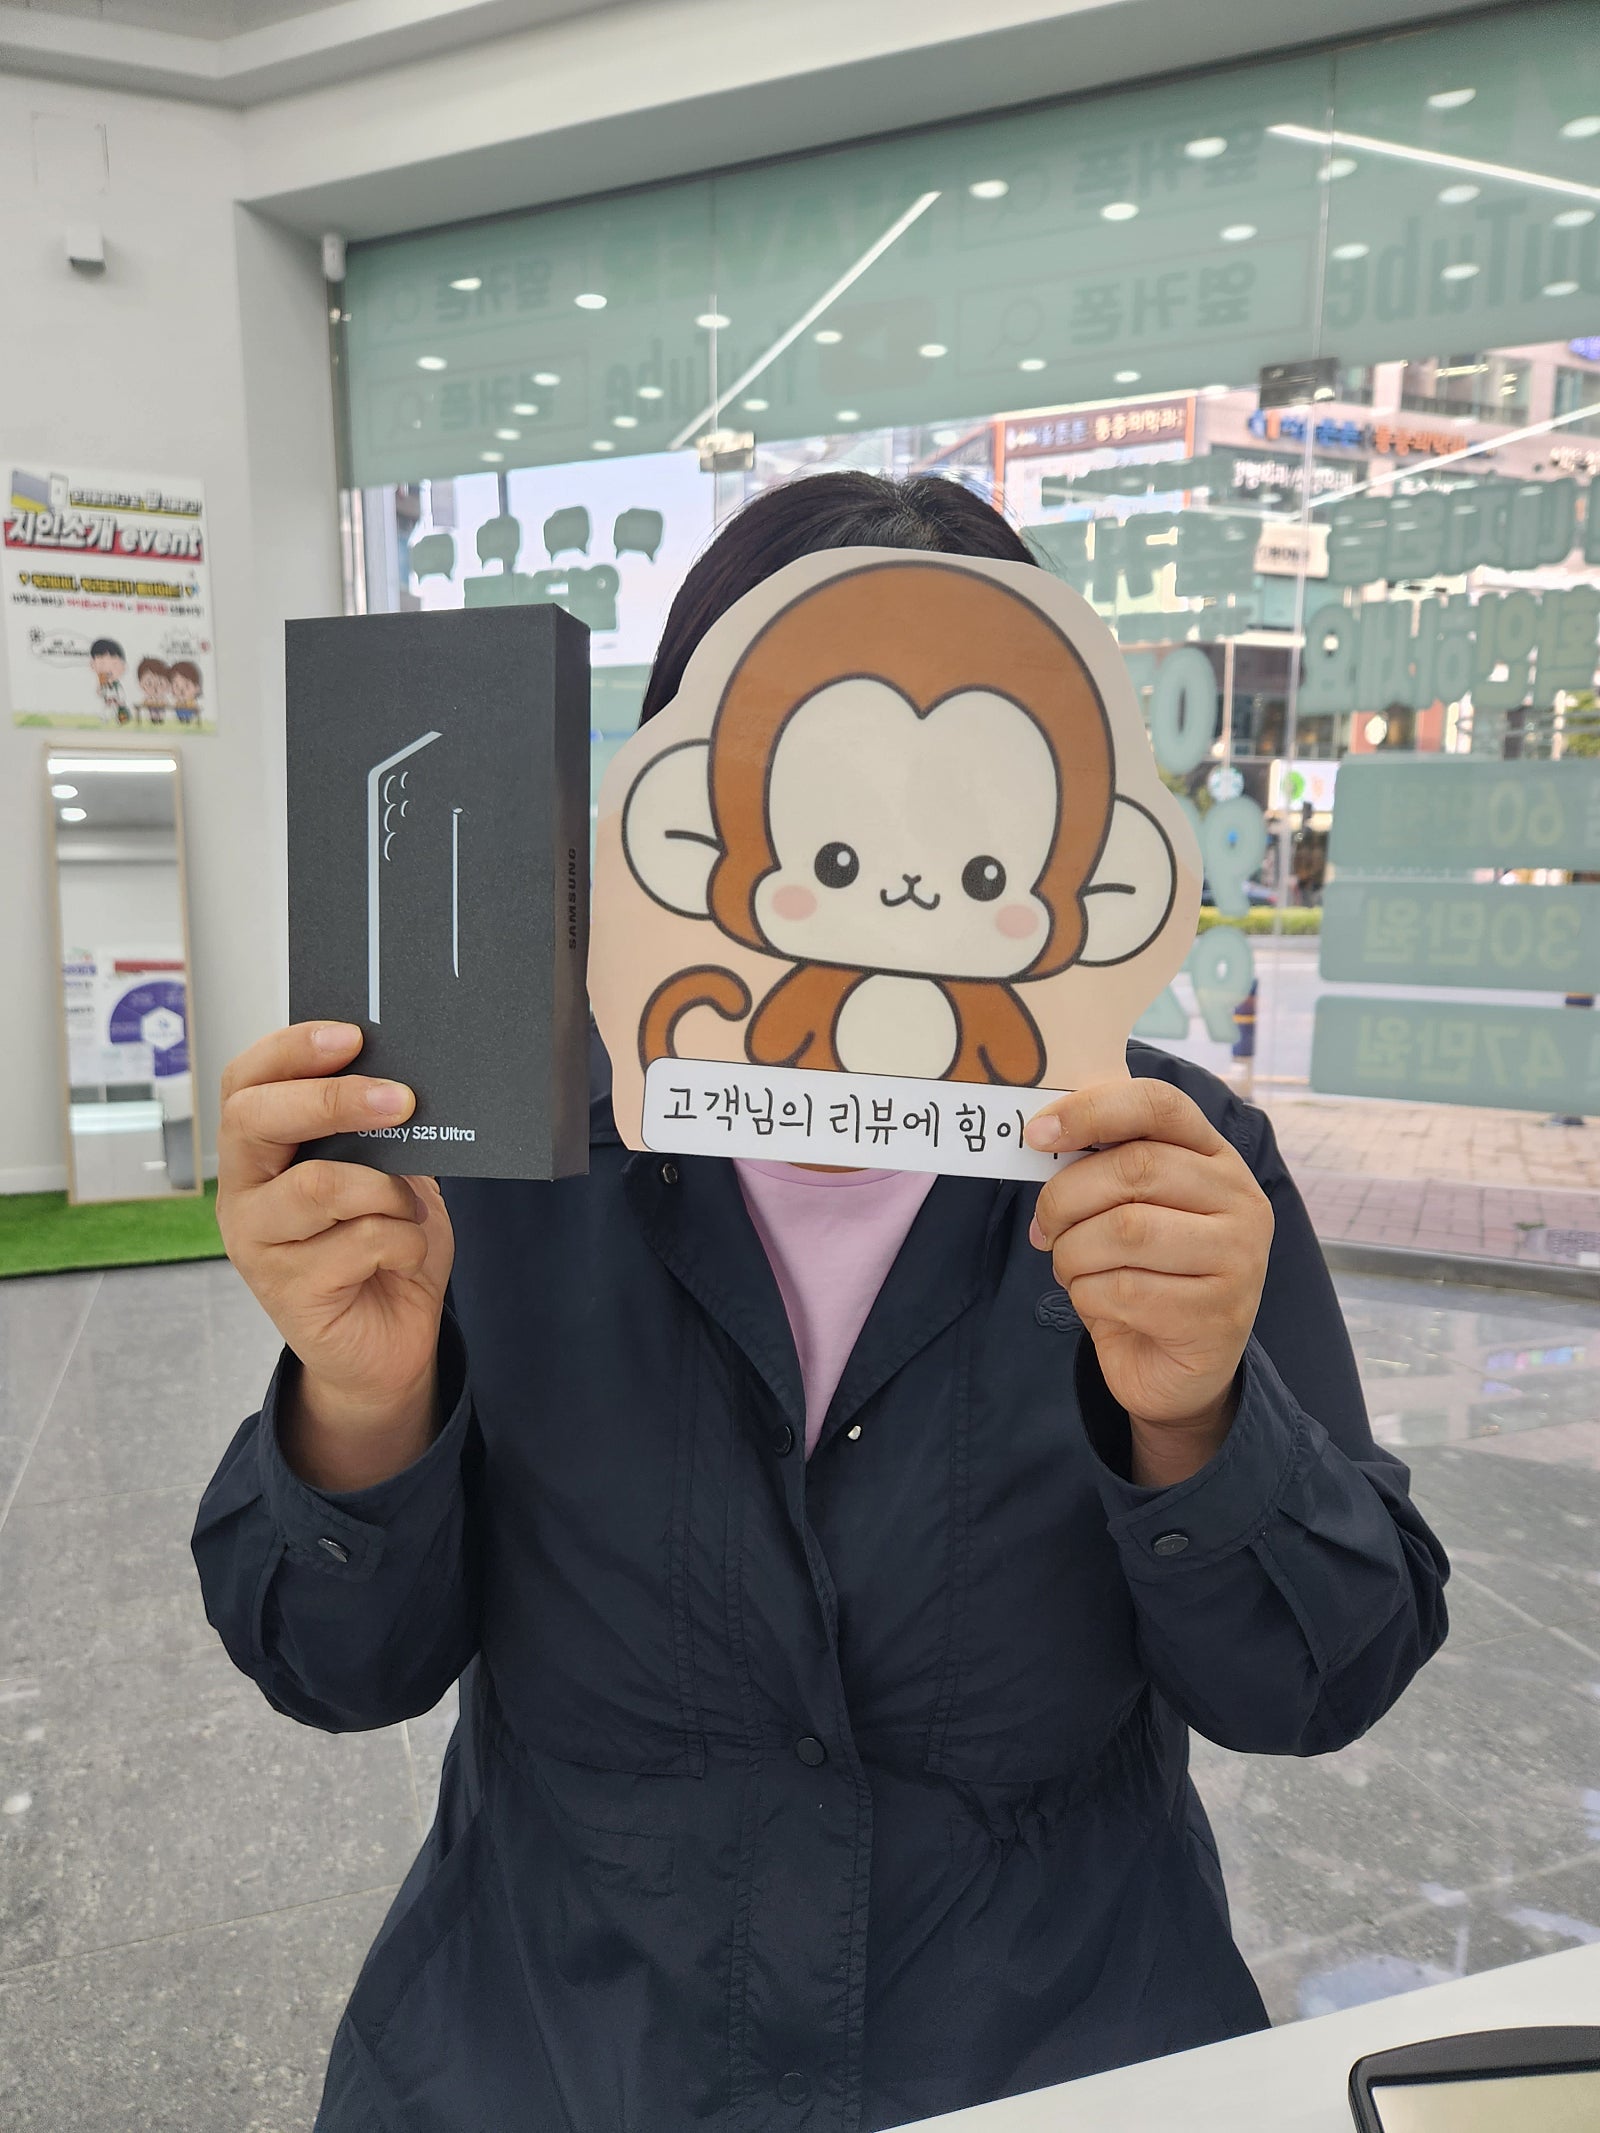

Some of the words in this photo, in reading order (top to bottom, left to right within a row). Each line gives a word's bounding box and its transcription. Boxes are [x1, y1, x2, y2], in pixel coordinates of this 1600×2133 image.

[8, 511, 116, 551] 지인소개
[119, 524, 203, 558] event
[567, 847, 577, 951] SAMSUNG
[412, 1125, 438, 1141] S25
[439, 1126, 476, 1142] Ultra
[662, 1083, 813, 1138] 고객님의
[829, 1094, 941, 1148] 리뷰에
